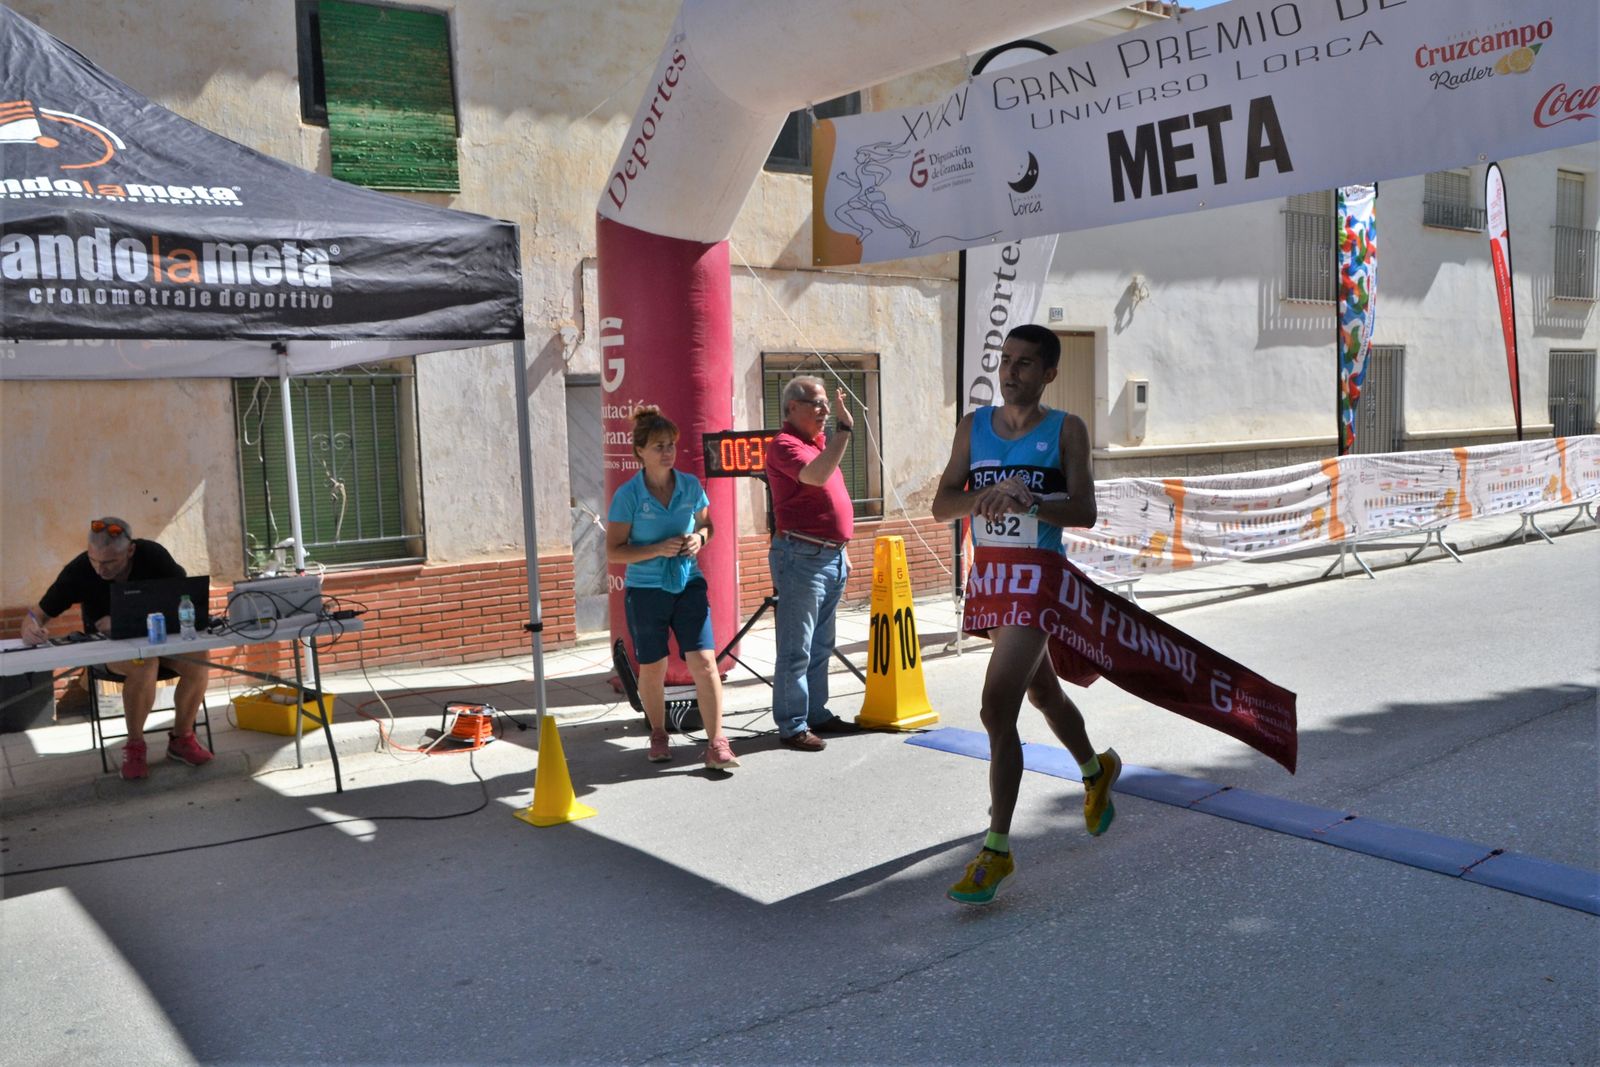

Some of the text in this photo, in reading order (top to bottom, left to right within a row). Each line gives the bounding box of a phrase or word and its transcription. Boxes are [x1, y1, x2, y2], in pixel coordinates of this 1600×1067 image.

[992, 60, 1097, 111] GRAN
[1118, 3, 1301, 79] PREMIO
[1336, 0, 1407, 21] D
[1031, 30, 1384, 131] UNIVERSO LORCA
[1415, 19, 1553, 69] Cruzcampo
[1430, 66, 1494, 90] Radler
[607, 48, 687, 212] Deportes
[1107, 95, 1295, 203] META
[29, 286, 333, 309] cronometraje deportivo
[968, 238, 1022, 408] Deporte
[870, 612, 891, 676] 10
[894, 606, 917, 671] 10
[1003, 601, 1031, 626] de
[1039, 608, 1113, 671] Granada
[1059, 569, 1093, 625] DE
[1101, 600, 1198, 684] FONDO
